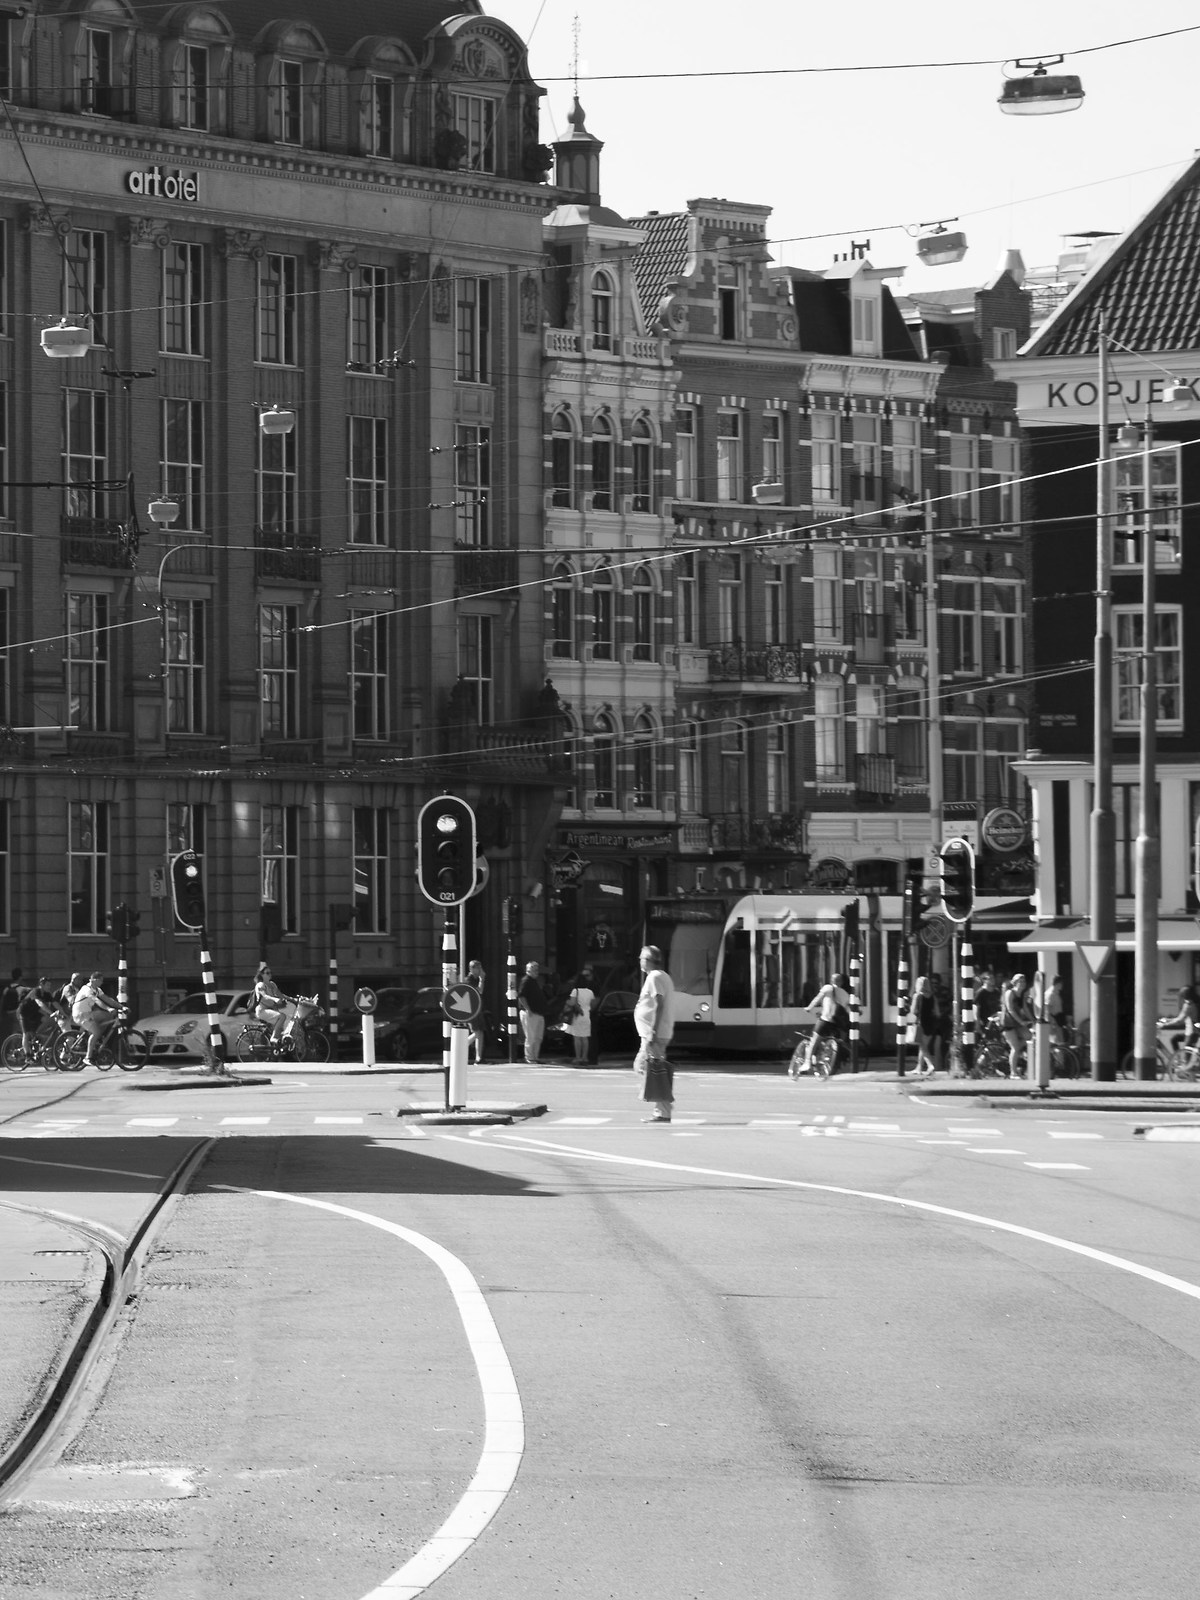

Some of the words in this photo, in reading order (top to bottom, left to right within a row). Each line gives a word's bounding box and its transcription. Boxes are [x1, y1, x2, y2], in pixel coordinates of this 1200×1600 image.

[129, 166, 162, 197] art
[164, 170, 200, 202] otel
[1048, 379, 1164, 407] KOPJE
[440, 892, 455, 901] 021
